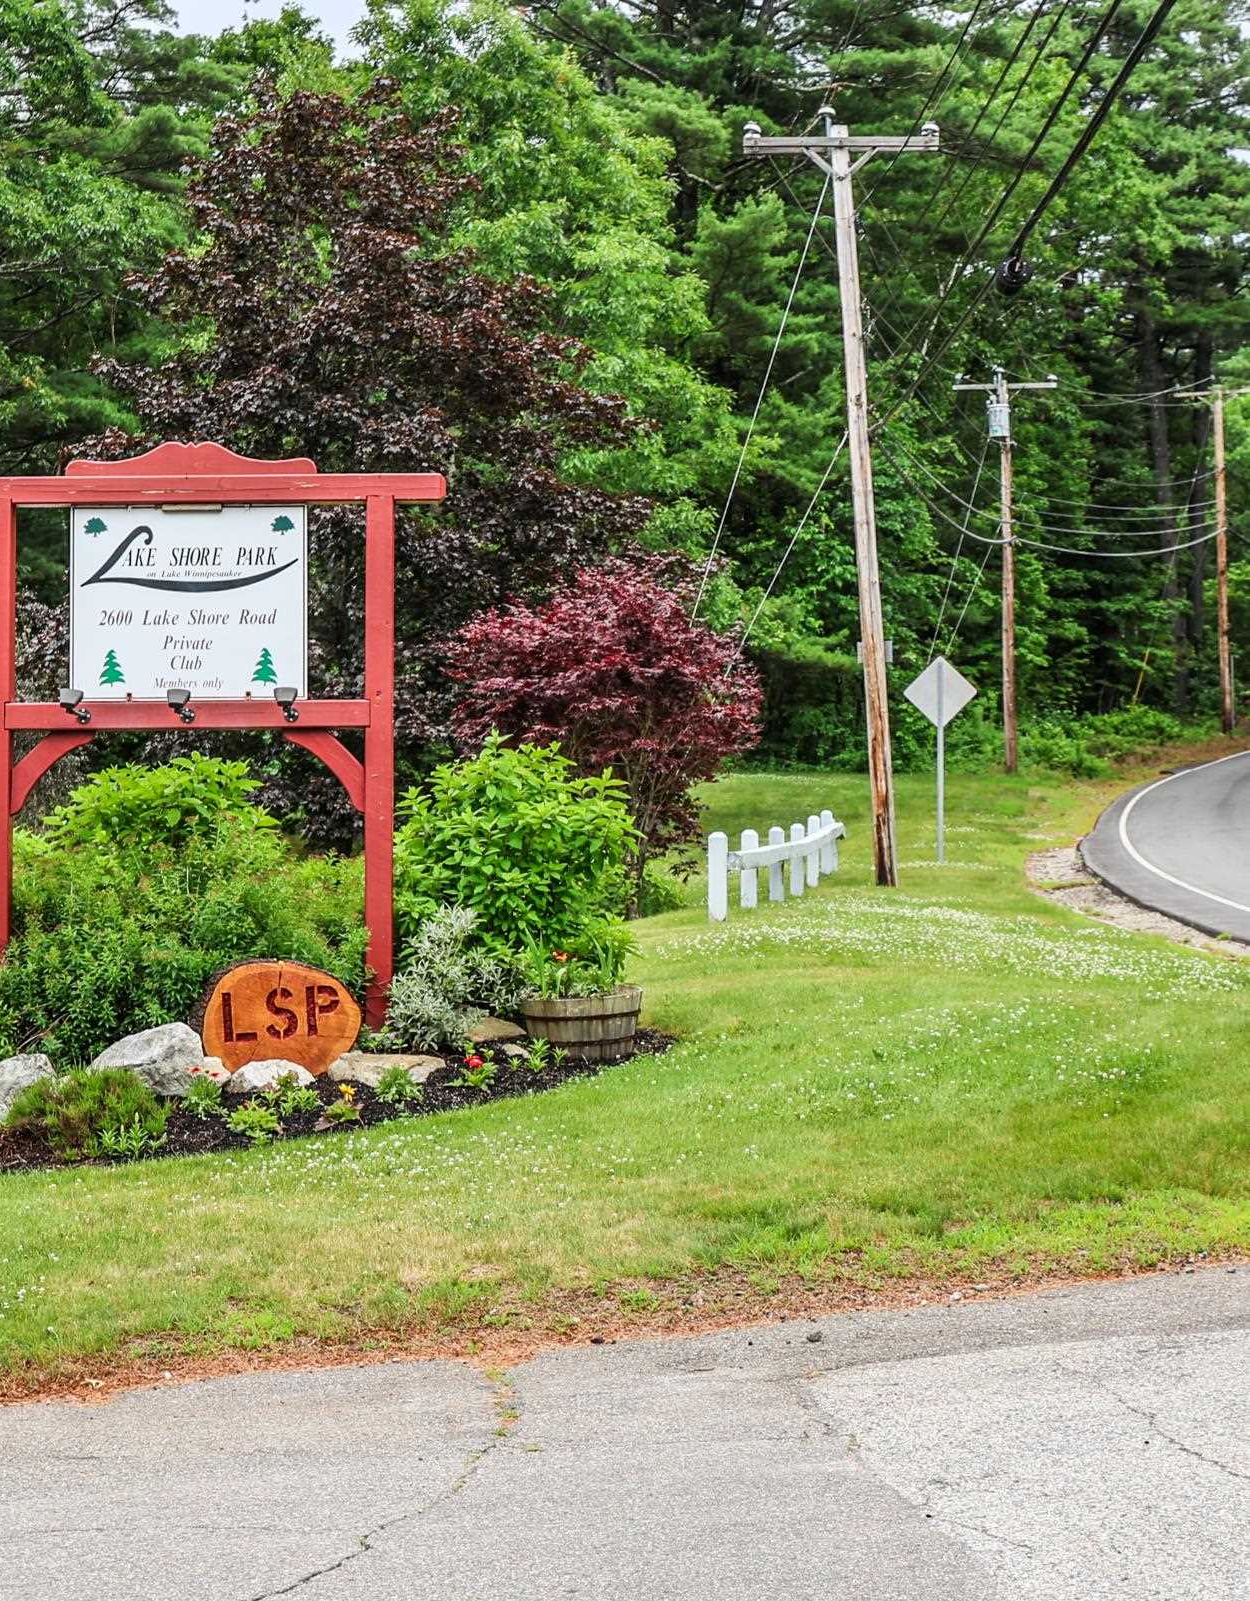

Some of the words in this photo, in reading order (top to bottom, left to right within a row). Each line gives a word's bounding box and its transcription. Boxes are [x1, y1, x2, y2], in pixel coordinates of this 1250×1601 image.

[169, 546, 223, 567] SHORE
[236, 546, 279, 567] PARK
[161, 570, 182, 578] Lake
[98, 609, 133, 627] 2600
[142, 608, 179, 626] Lake
[187, 608, 230, 626] Shore
[238, 607, 278, 626] Road
[162, 634, 213, 651] Private
[170, 654, 203, 671] Club
[153, 677, 199, 689] Members
[202, 677, 224, 690] only
[221, 985, 340, 1043] LSP
